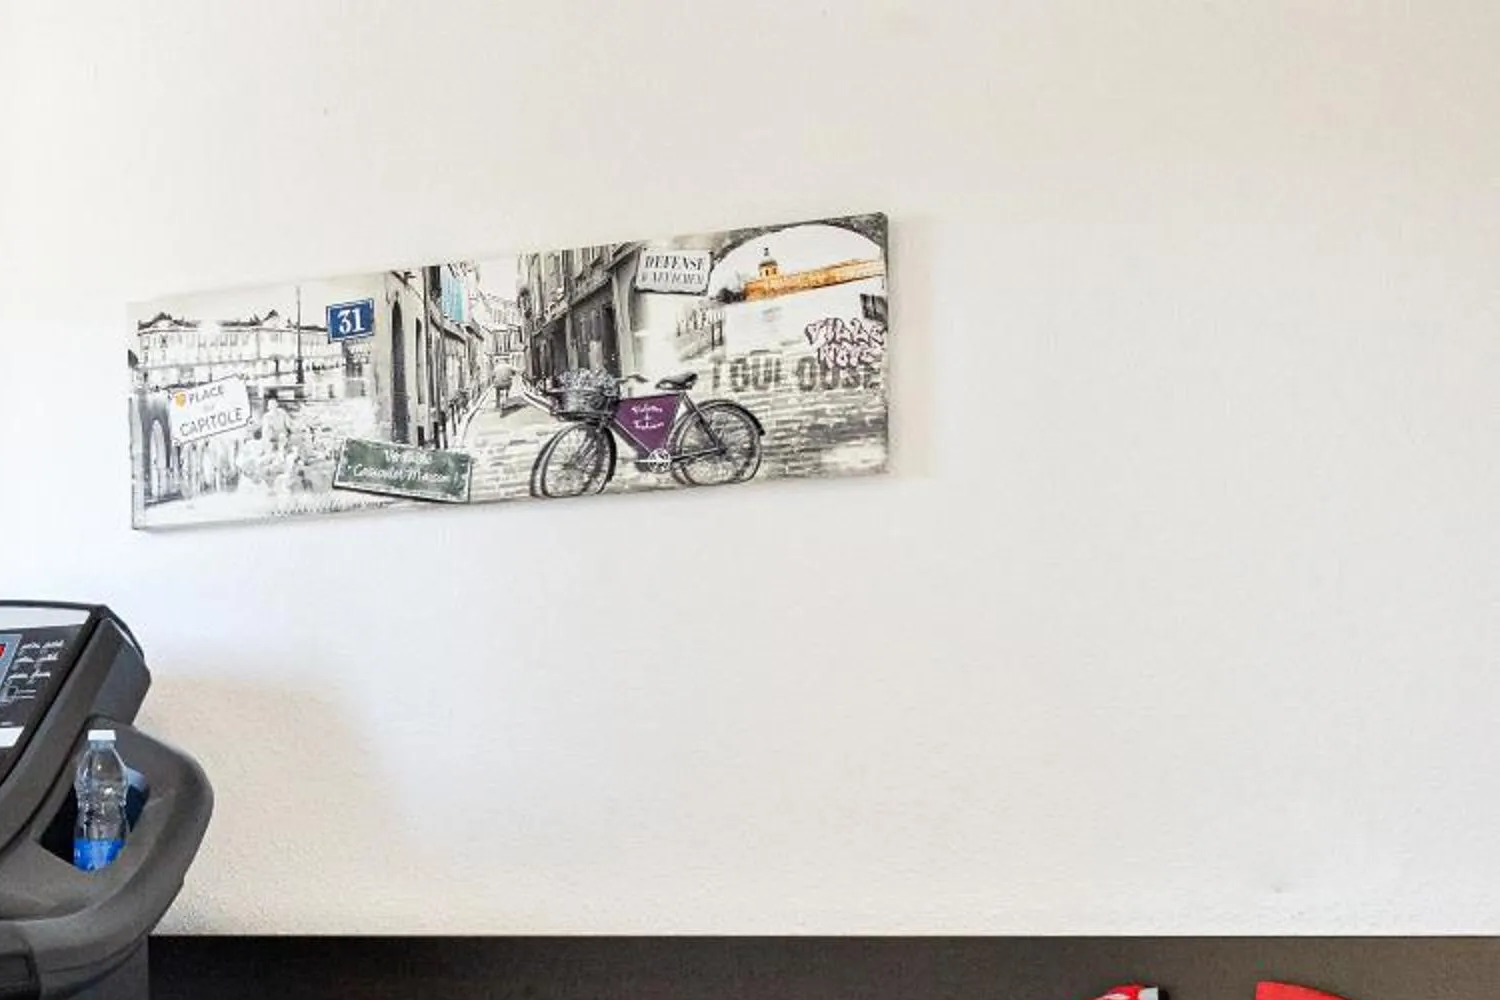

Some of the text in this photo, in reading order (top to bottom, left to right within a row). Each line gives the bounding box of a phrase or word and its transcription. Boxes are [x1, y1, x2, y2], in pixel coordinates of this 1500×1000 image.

[337, 307, 366, 335] 31
[189, 385, 224, 405] PLACE
[180, 407, 243, 436] CAPITOLE
